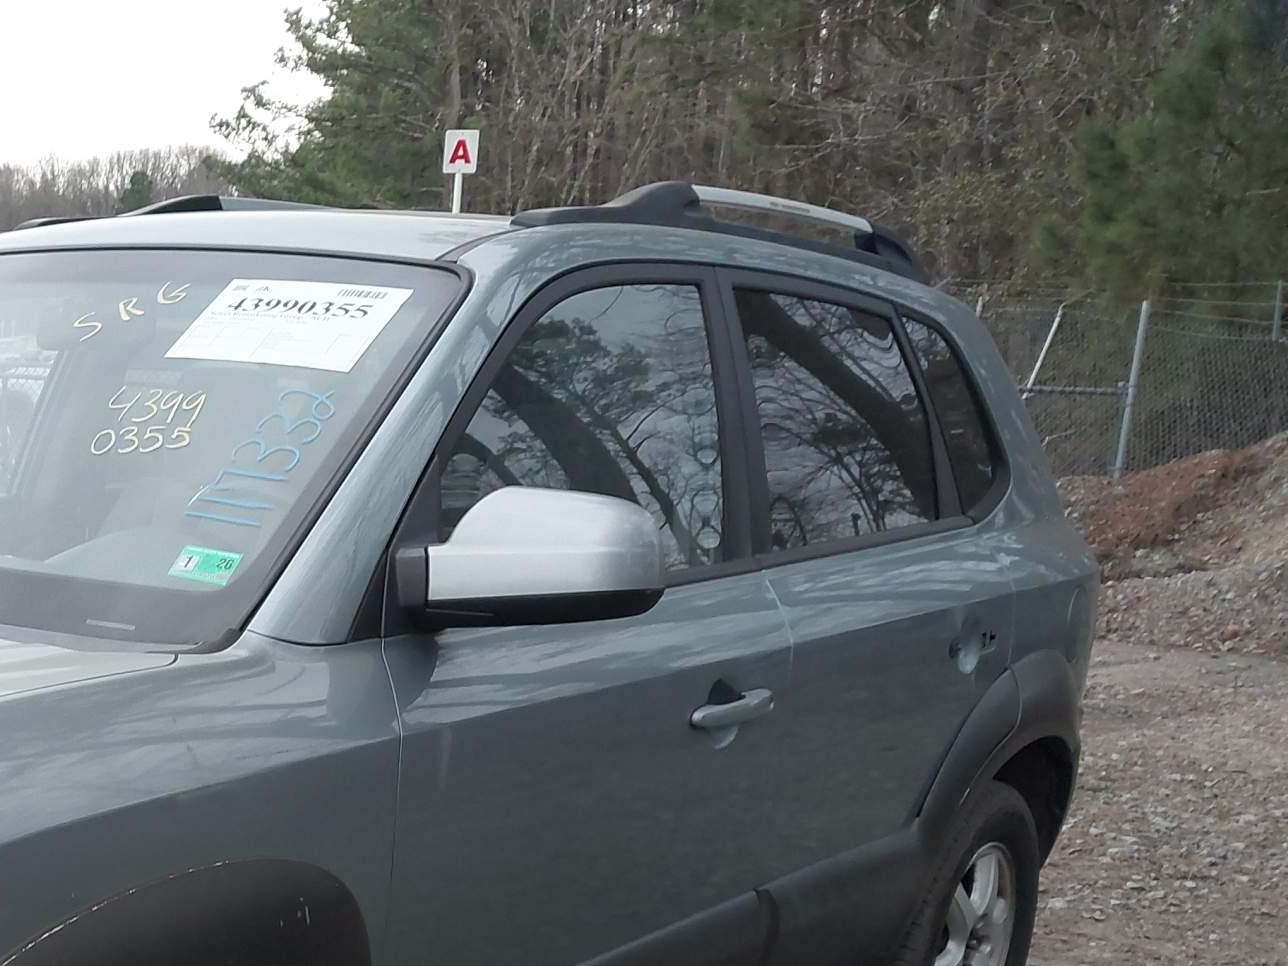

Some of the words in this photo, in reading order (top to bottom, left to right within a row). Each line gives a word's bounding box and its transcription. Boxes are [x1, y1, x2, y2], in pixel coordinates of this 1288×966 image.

[448, 139, 472, 165] A
[226, 296, 375, 320] 43990355
[108, 385, 207, 430] 4399
[90, 425, 193, 456] 0355
